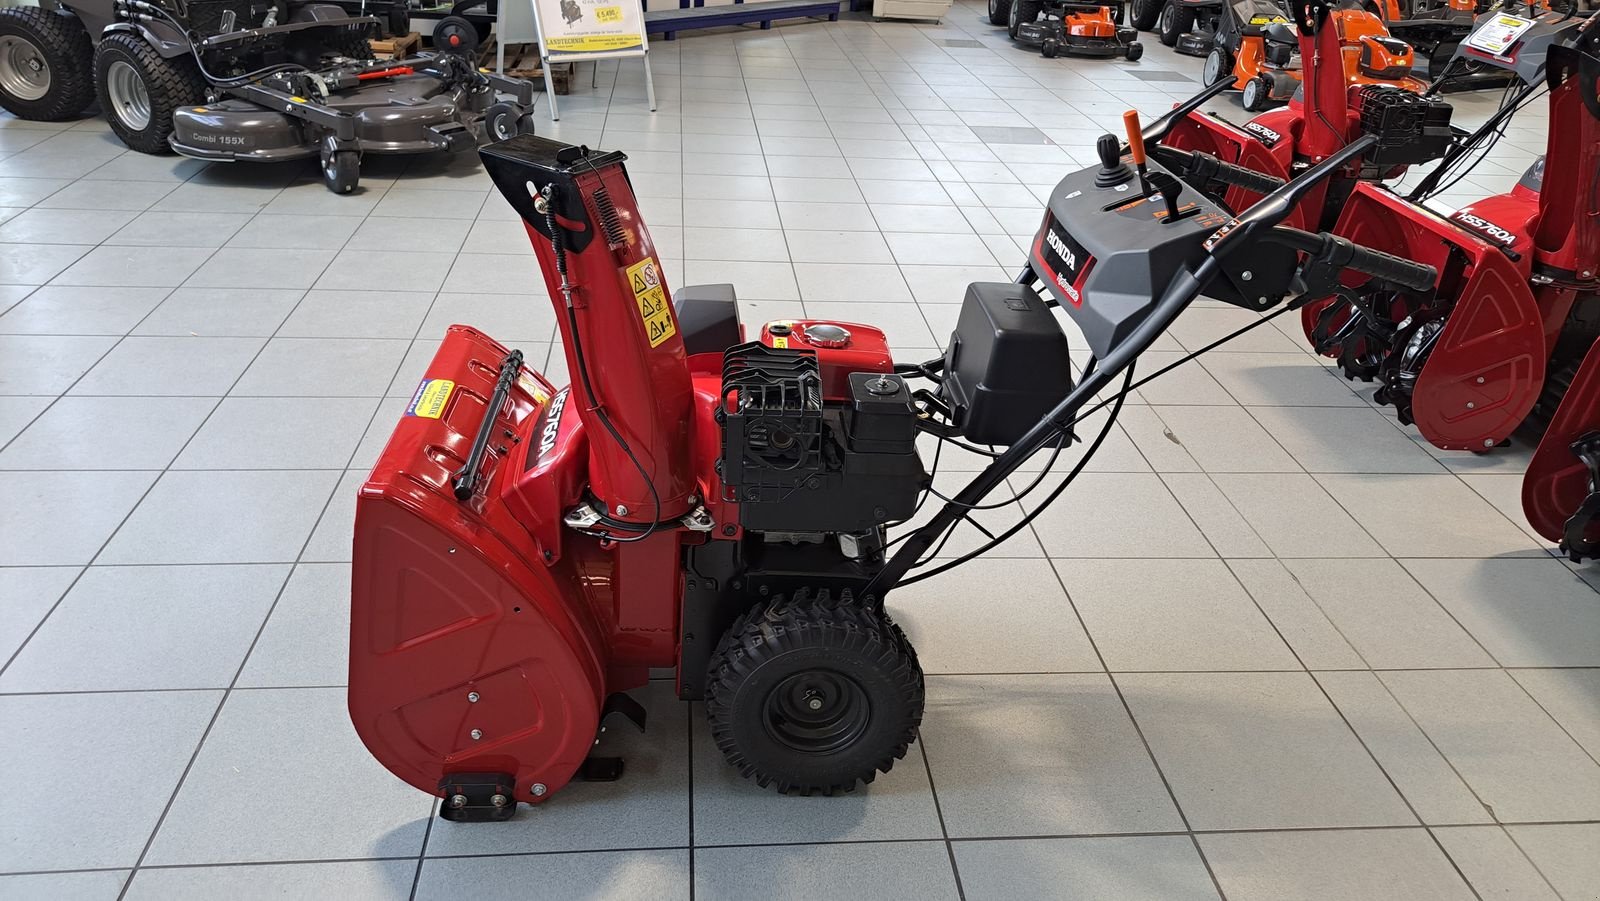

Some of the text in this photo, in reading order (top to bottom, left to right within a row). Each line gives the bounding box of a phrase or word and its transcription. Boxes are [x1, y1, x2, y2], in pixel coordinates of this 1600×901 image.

[192, 132, 245, 144] Combi 155X
[1456, 212, 1517, 245] HSS760A
[1046, 228, 1076, 271] HONDA
[538, 386, 570, 458] HSS760A
